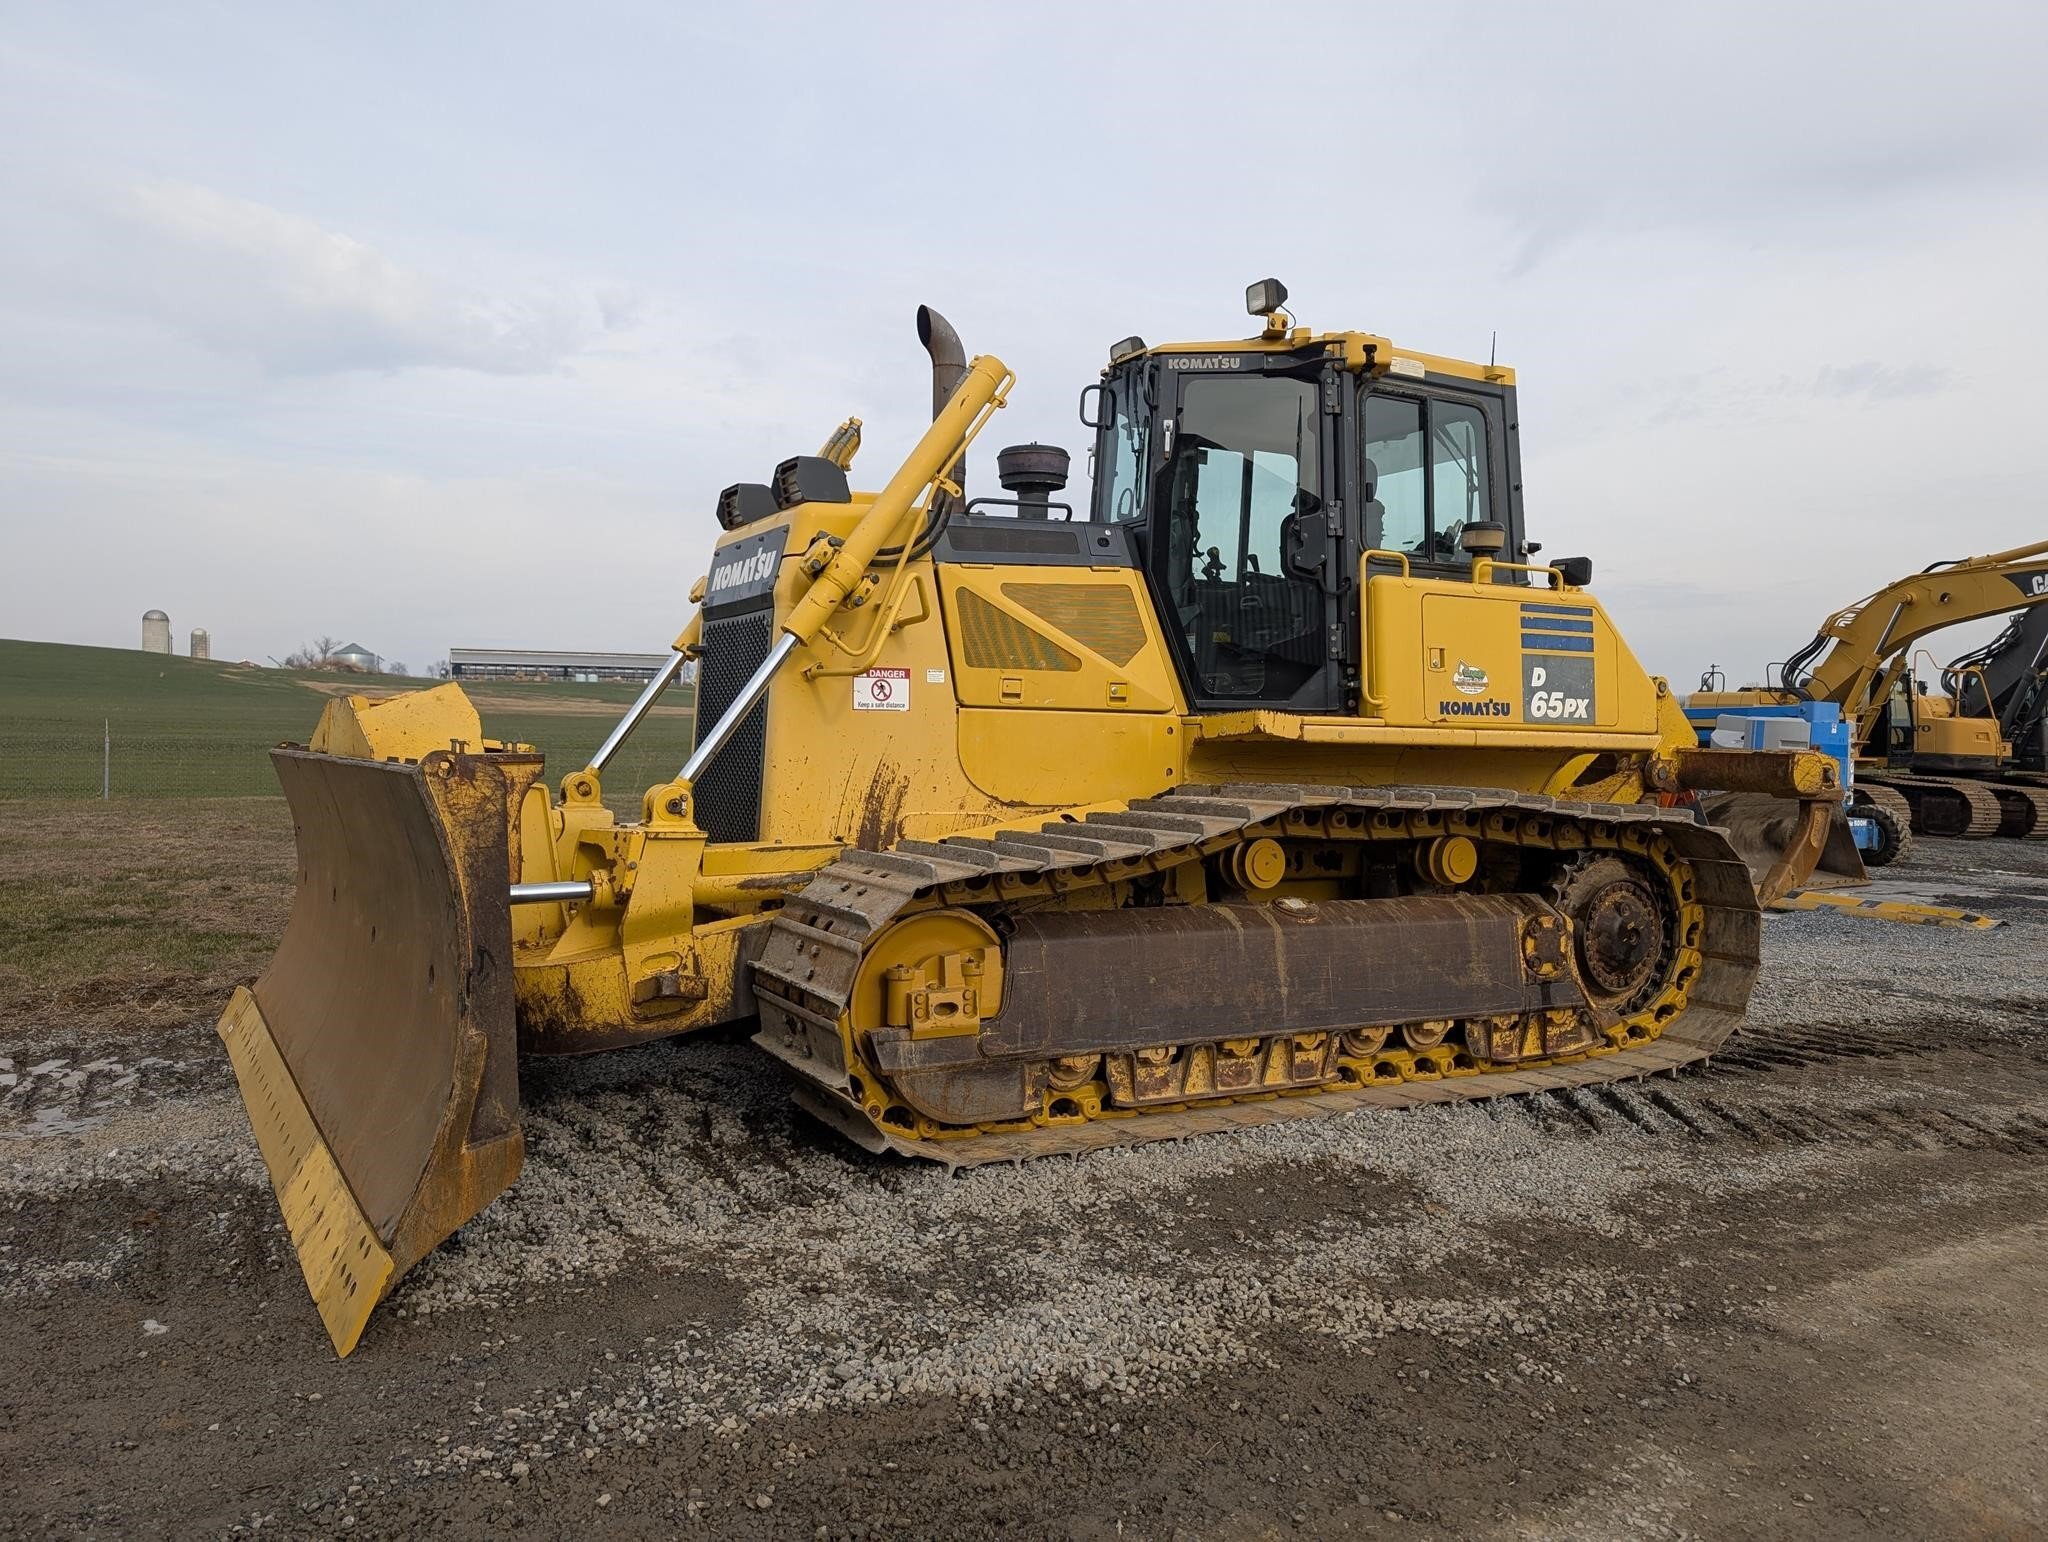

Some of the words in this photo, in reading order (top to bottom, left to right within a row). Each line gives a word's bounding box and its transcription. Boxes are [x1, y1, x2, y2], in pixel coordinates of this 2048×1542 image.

[1168, 355, 1240, 369] KOMATSU
[711, 547, 777, 592] KOMATSU
[869, 669, 906, 678] DANGER
[1531, 667, 1546, 687] D
[1440, 698, 1511, 716] KOMATSU
[1531, 691, 1590, 718] 65PX
